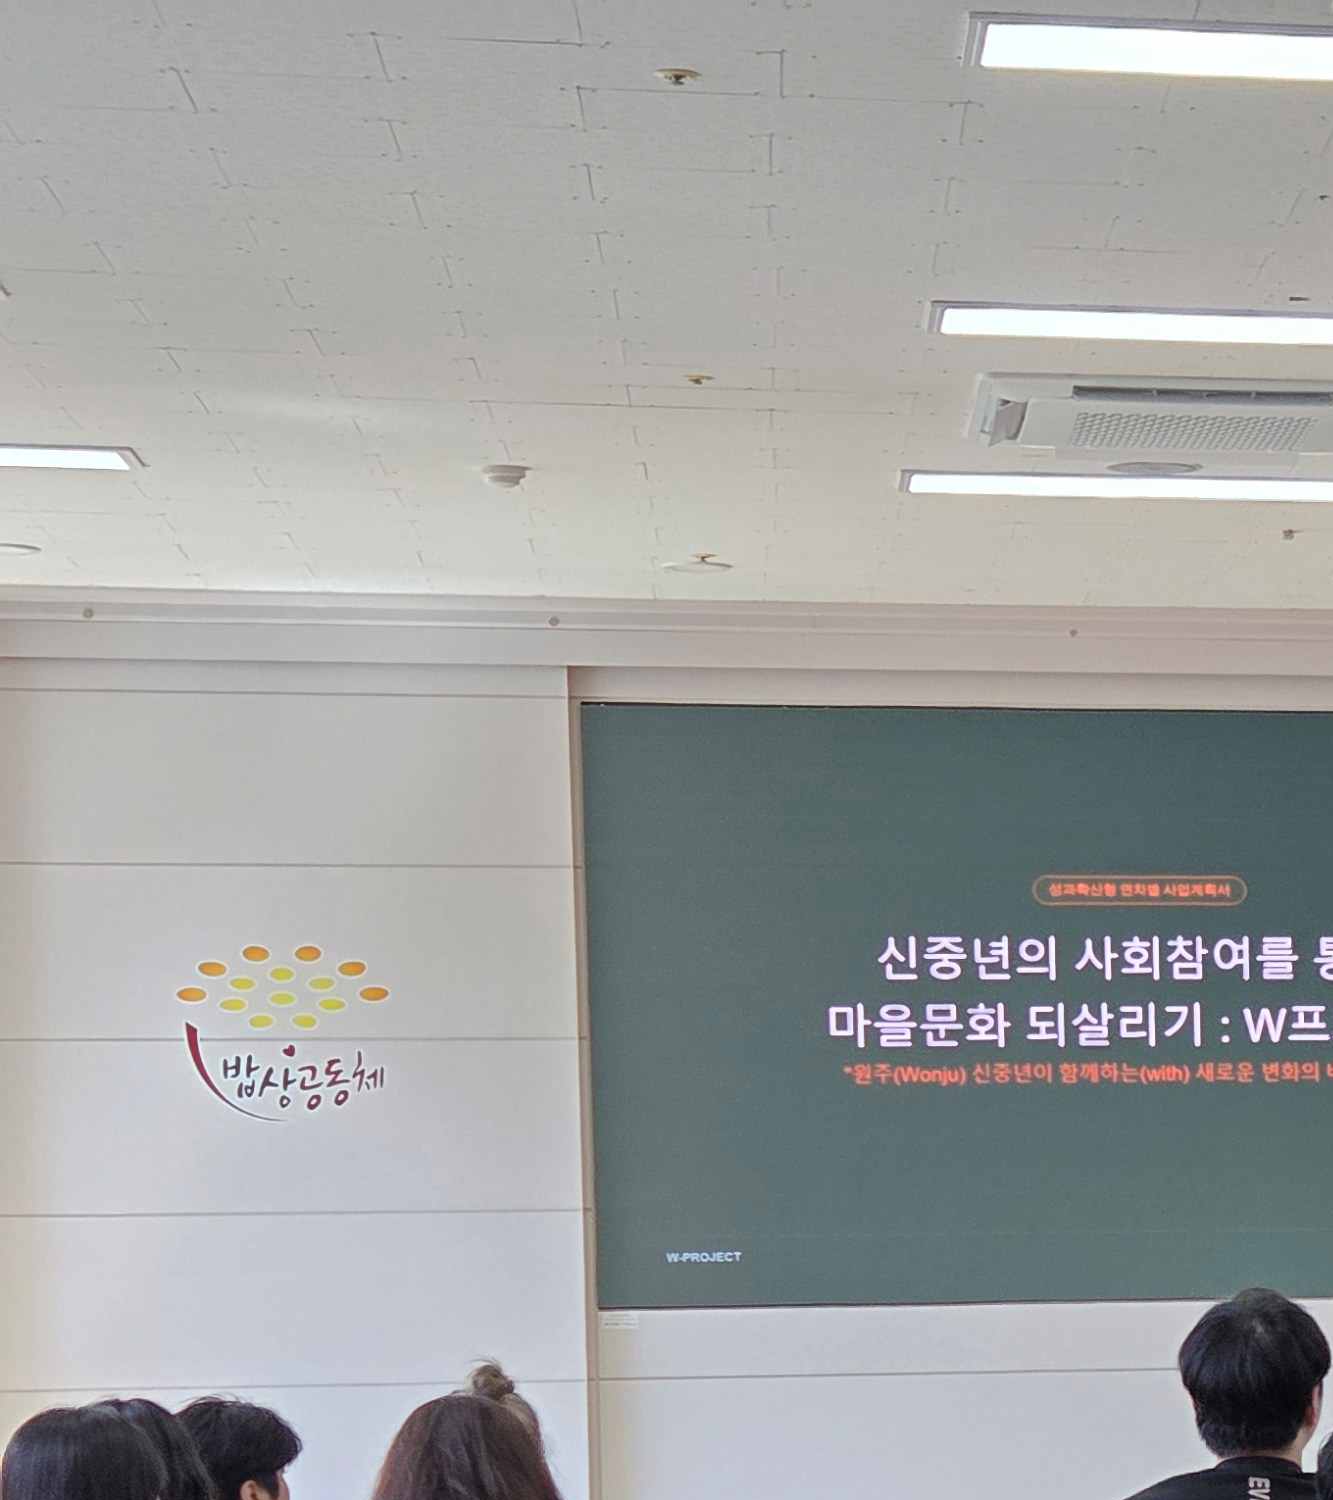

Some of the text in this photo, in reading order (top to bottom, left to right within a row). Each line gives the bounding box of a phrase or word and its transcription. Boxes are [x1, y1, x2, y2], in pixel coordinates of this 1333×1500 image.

[877, 934, 1057, 981] 신중년의
[1074, 934, 1299, 981] 사회참여를
[828, 1001, 1012, 1048] 마을문화
[1025, 1000, 1202, 1048] 되살리기
[1220, 1015, 1231, 1044] :
[221, 1050, 386, 1111] 밥상공동체
[971, 1062, 1052, 1084] 신중년이
[1058, 1061, 1189, 1083] 함께하는(with)
[1195, 1061, 1254, 1082] 새로운
[1261, 1061, 1320, 1082] 변화의
[665, 1251, 742, 1263] W-PROJECT
